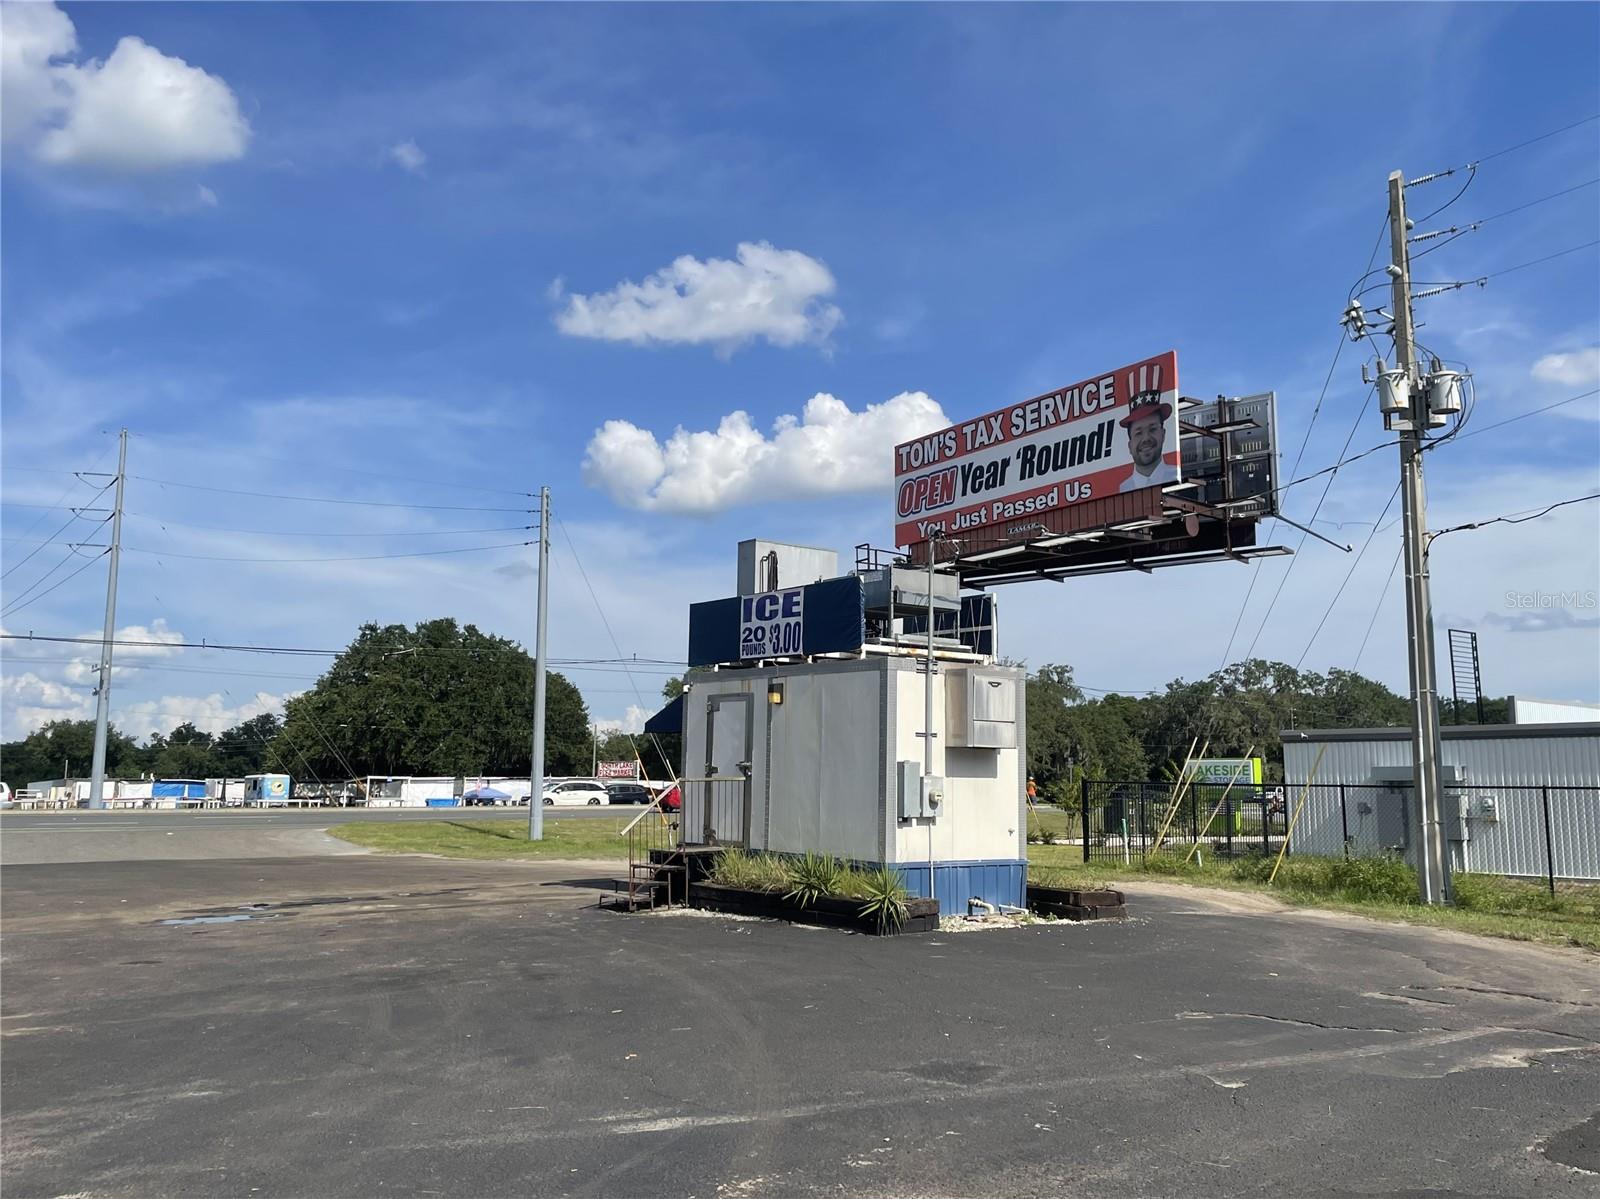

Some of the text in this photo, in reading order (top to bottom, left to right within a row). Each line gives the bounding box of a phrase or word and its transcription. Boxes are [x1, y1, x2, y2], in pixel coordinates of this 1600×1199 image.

[899, 375, 1115, 472] TOM'S TAX SERVICE
[899, 466, 957, 516] OPEN
[960, 460, 1011, 497] Year
[951, 507, 987, 531] Just
[992, 486, 1060, 520] Passed
[1064, 481, 1092, 502] Us
[743, 591, 801, 623] ICE
[742, 621, 802, 655] 20 $3.00
[742, 643, 766, 657] POUNDS
[1189, 764, 1251, 776] LAKESIDE
